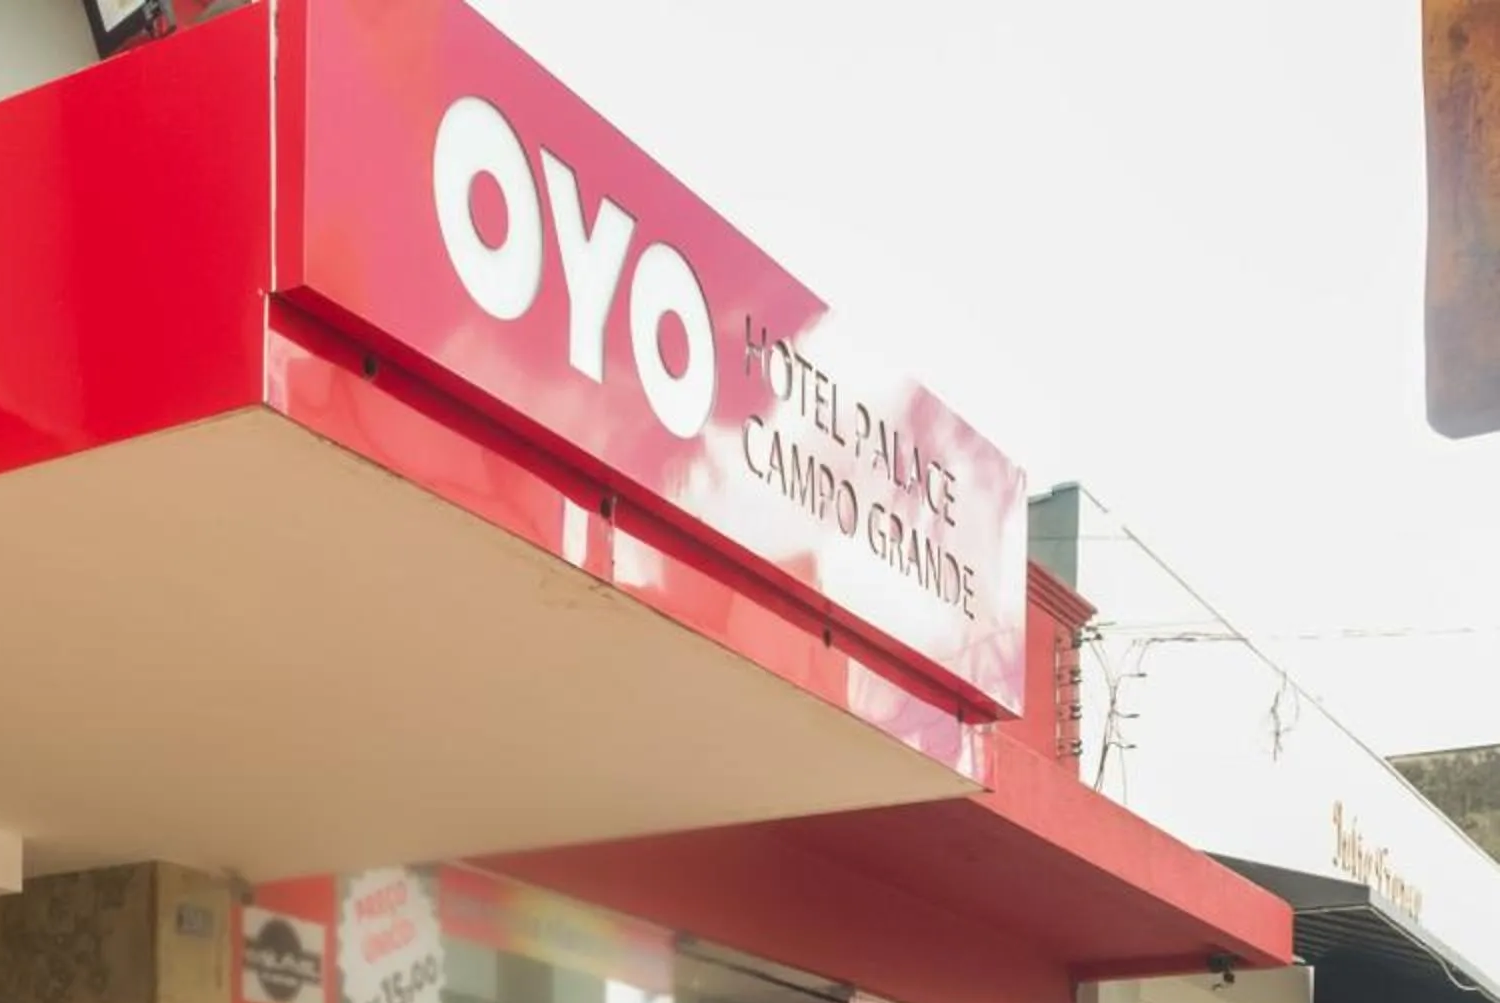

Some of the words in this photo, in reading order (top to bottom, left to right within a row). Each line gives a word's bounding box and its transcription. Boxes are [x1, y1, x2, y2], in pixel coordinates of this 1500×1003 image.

[433, 95, 716, 439] OYO
[742, 413, 859, 539] CAMPO
[867, 502, 975, 621] GRANDE
[745, 313, 846, 448] HOTEL
[855, 402, 956, 528] PALACE
